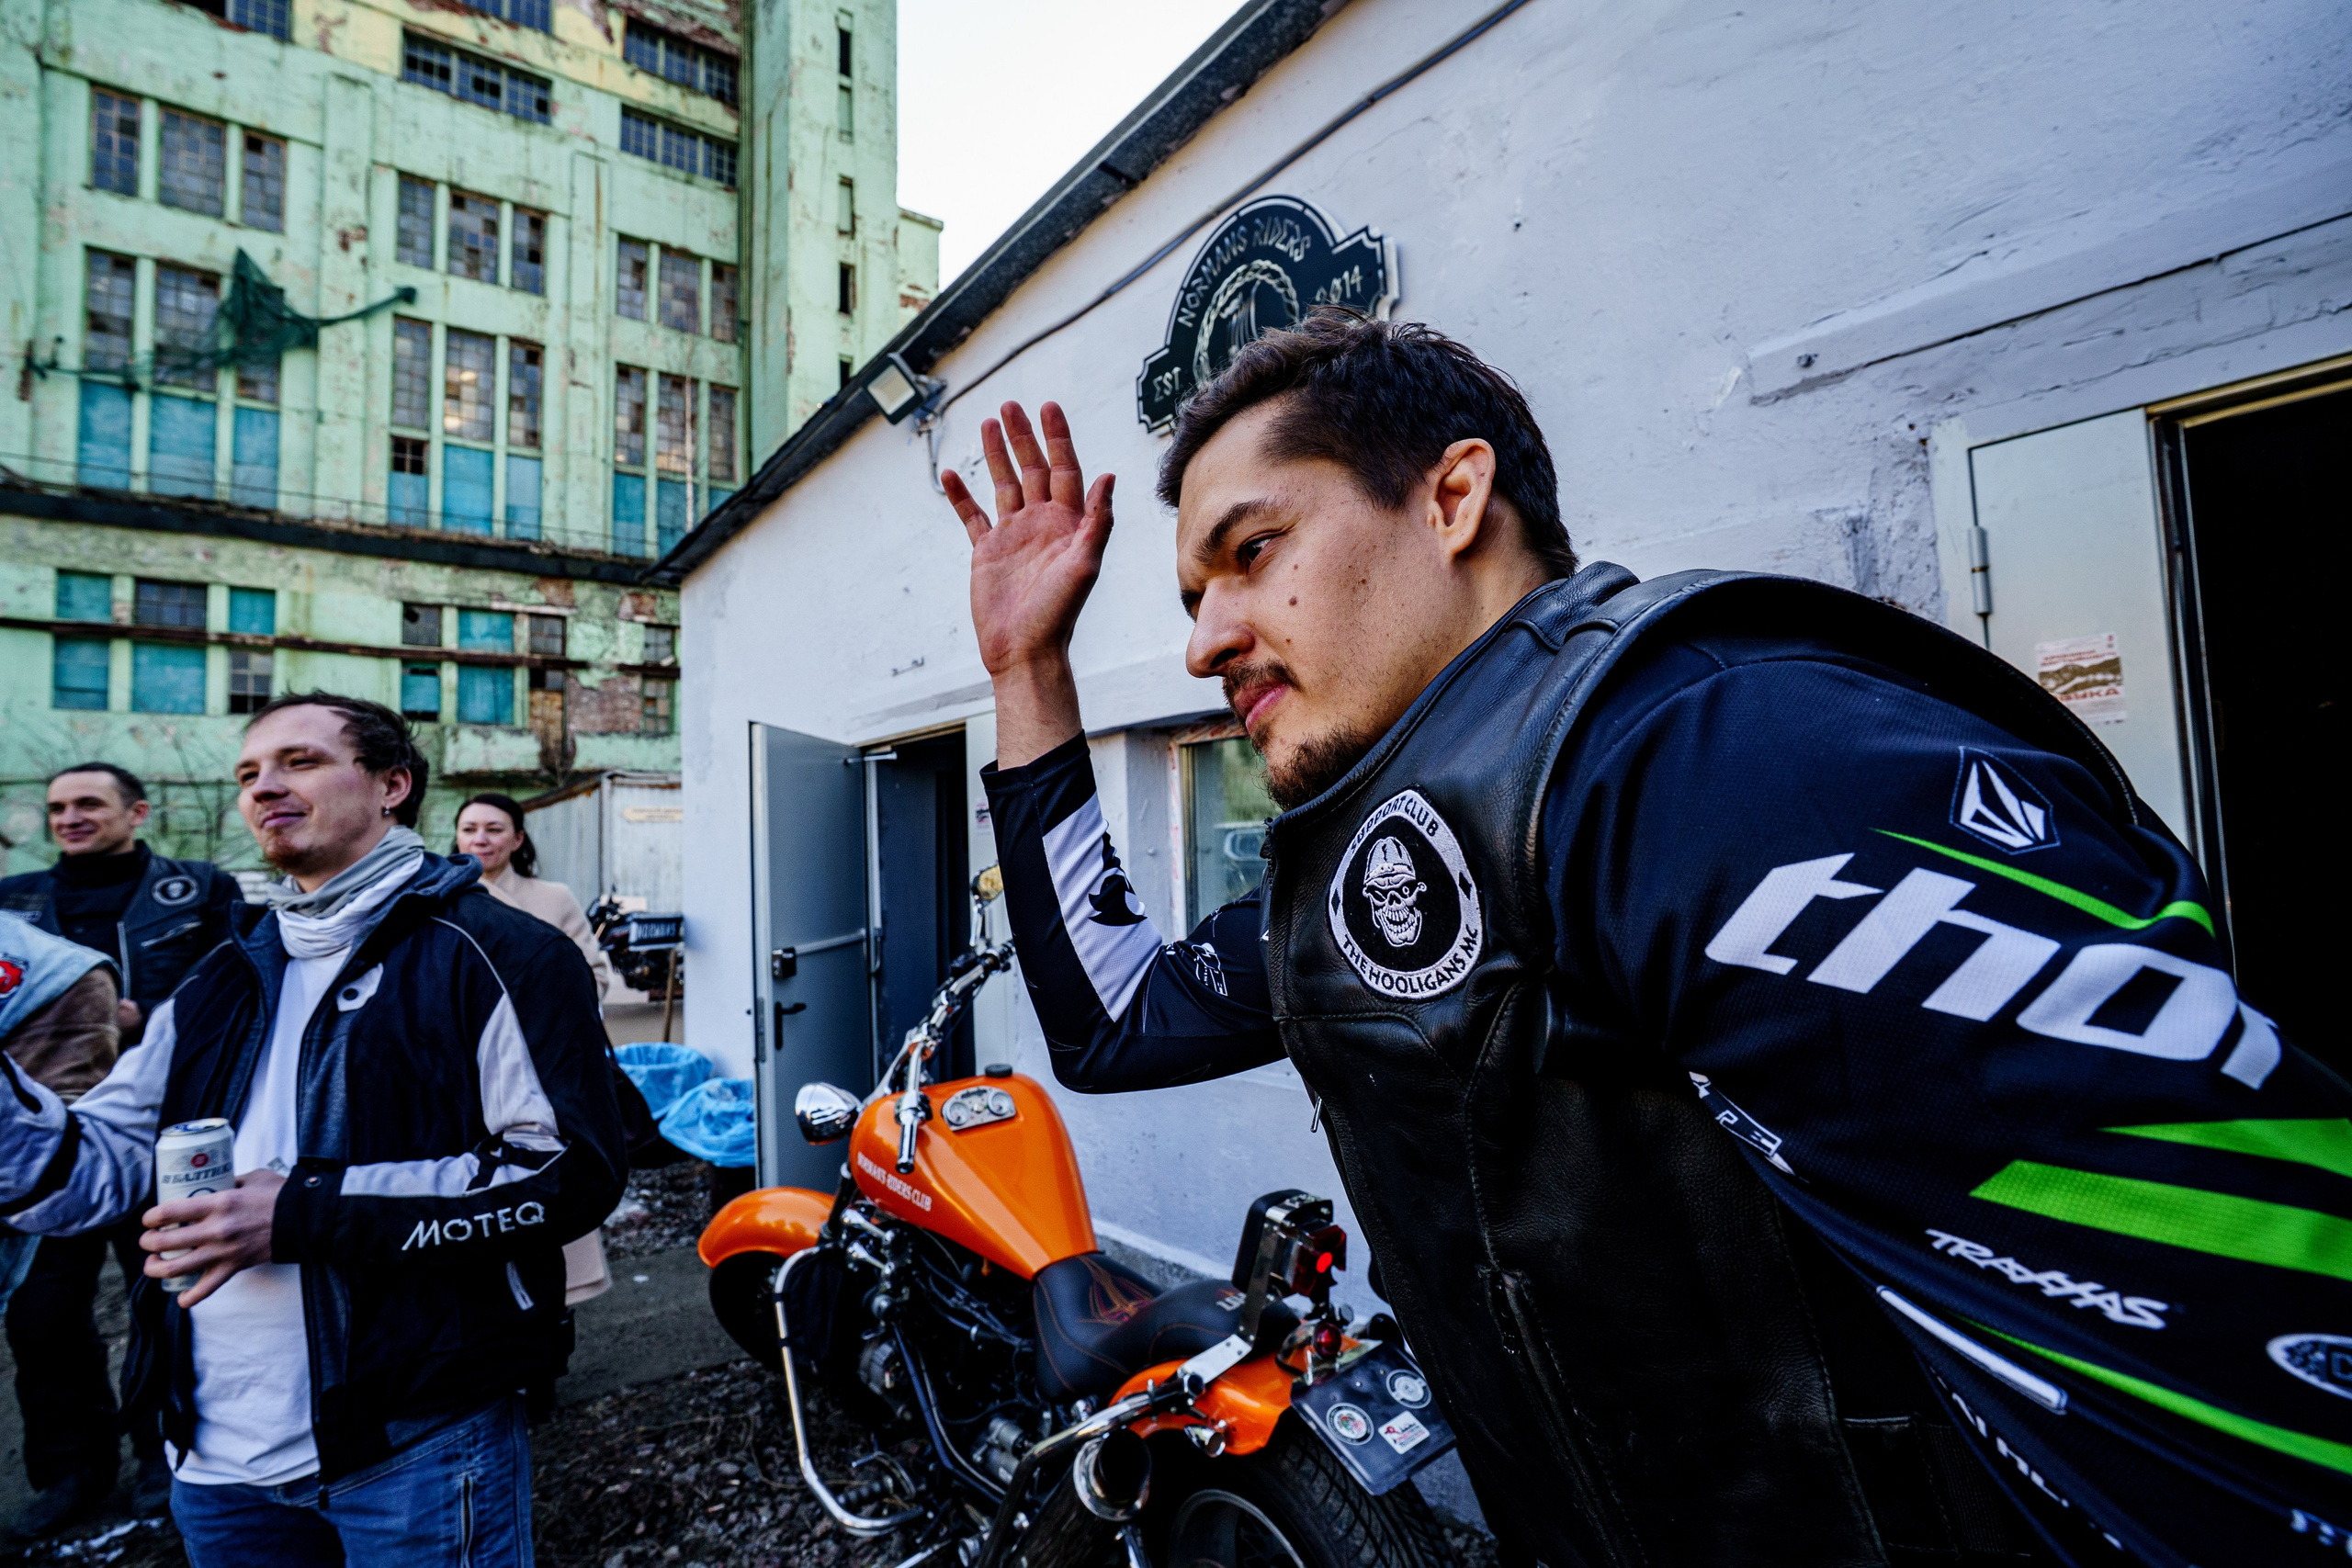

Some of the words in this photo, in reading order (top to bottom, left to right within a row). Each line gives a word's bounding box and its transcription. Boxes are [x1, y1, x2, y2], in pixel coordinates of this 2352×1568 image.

[1177, 224, 1248, 328] NORMANS
[1252, 216, 1311, 263] RIDERS
[1315, 265, 1363, 307] 2014
[1350, 795, 1406, 854] SUPPORT
[1404, 798, 1439, 838] CLUB
[1342, 933, 1366, 972] THE
[1367, 953, 1466, 994] HOOLIGANS
[1460, 923, 1478, 959] MC
[401, 1201, 545, 1250] MOTEQ
[911, 1189, 932, 1212] CLUB
[1925, 1227, 2169, 1330] TRAXXAS
